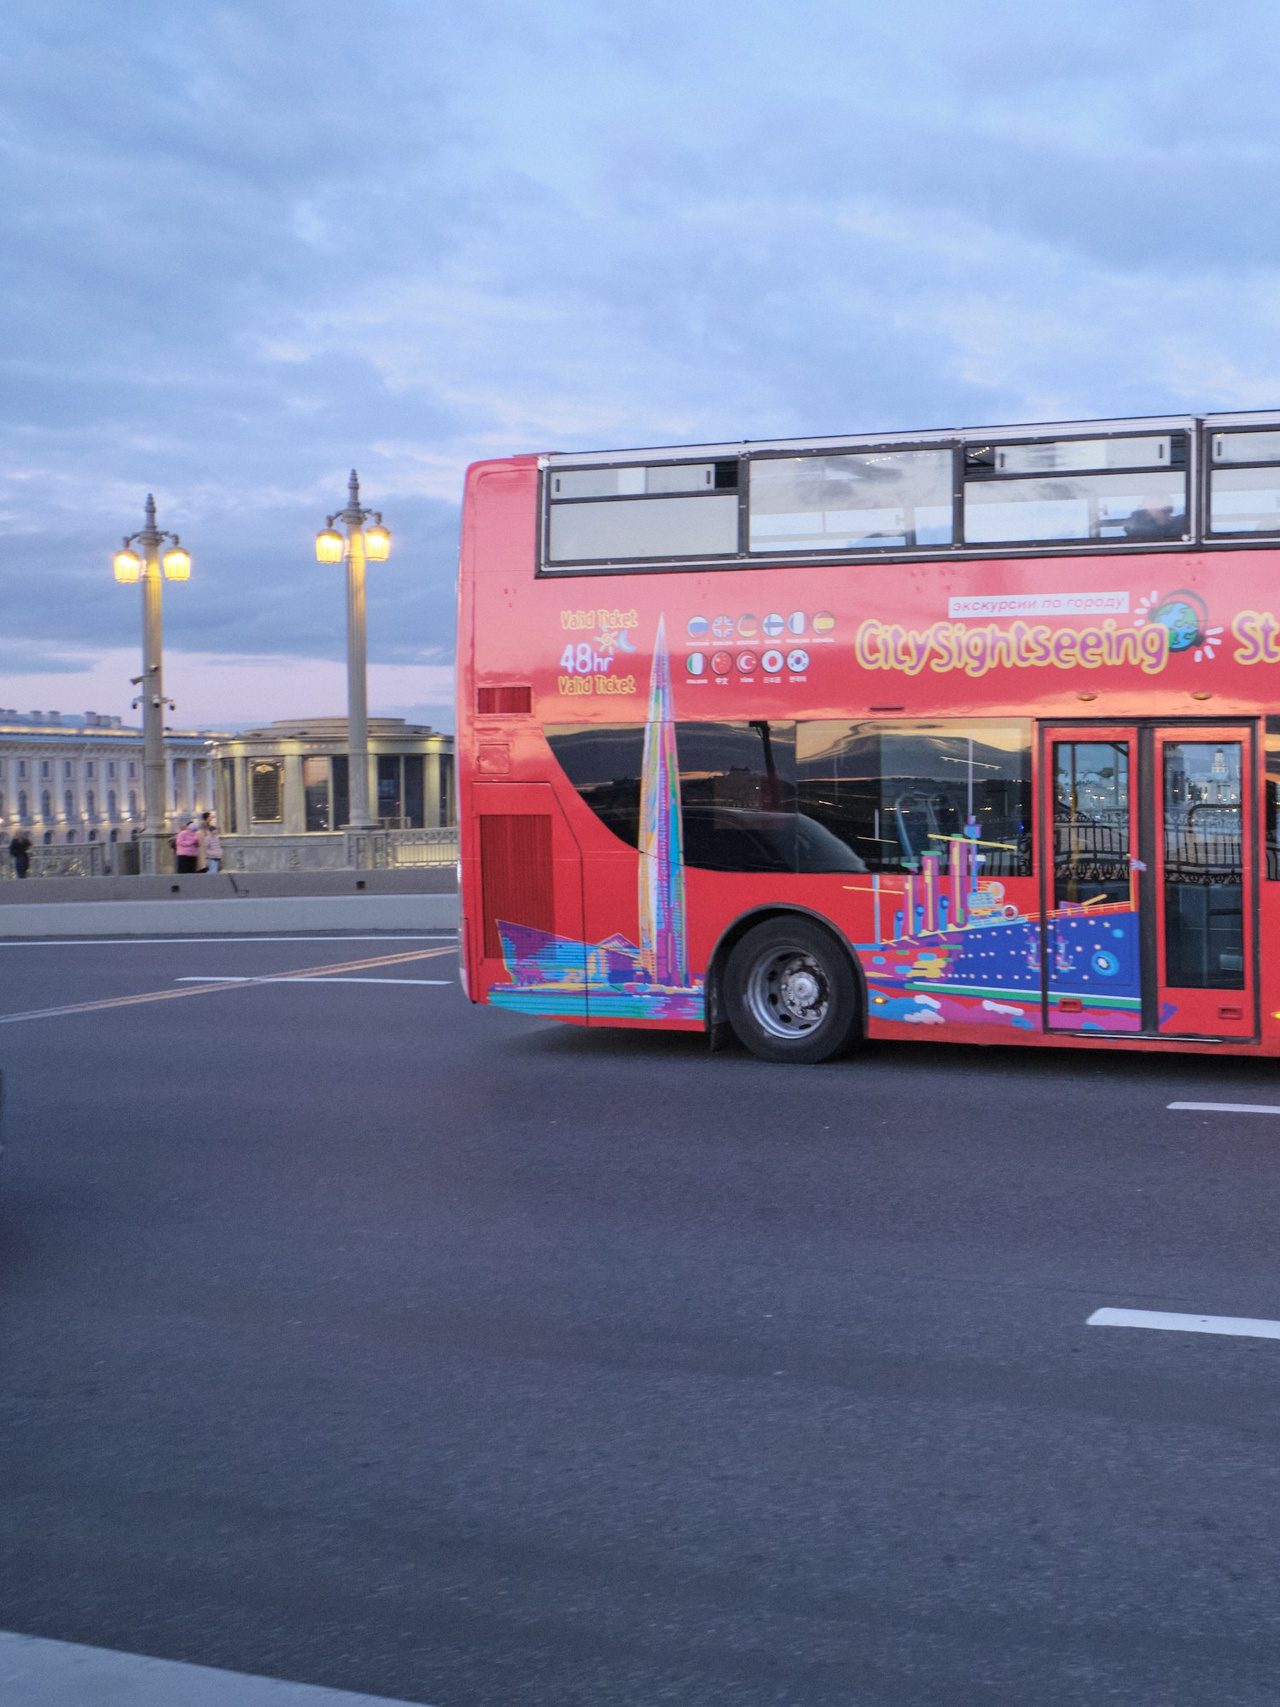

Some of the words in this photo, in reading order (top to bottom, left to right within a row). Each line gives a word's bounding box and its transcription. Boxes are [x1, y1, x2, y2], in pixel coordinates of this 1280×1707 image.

[952, 597, 1038, 613] экскурсии
[1041, 598, 1063, 609] по
[1065, 595, 1126, 611] городу
[561, 611, 595, 630] Valid
[597, 609, 638, 629] Ticket
[855, 618, 1168, 677] CitySightseeing
[558, 675, 593, 695] Valid
[594, 674, 636, 694] Ticket
